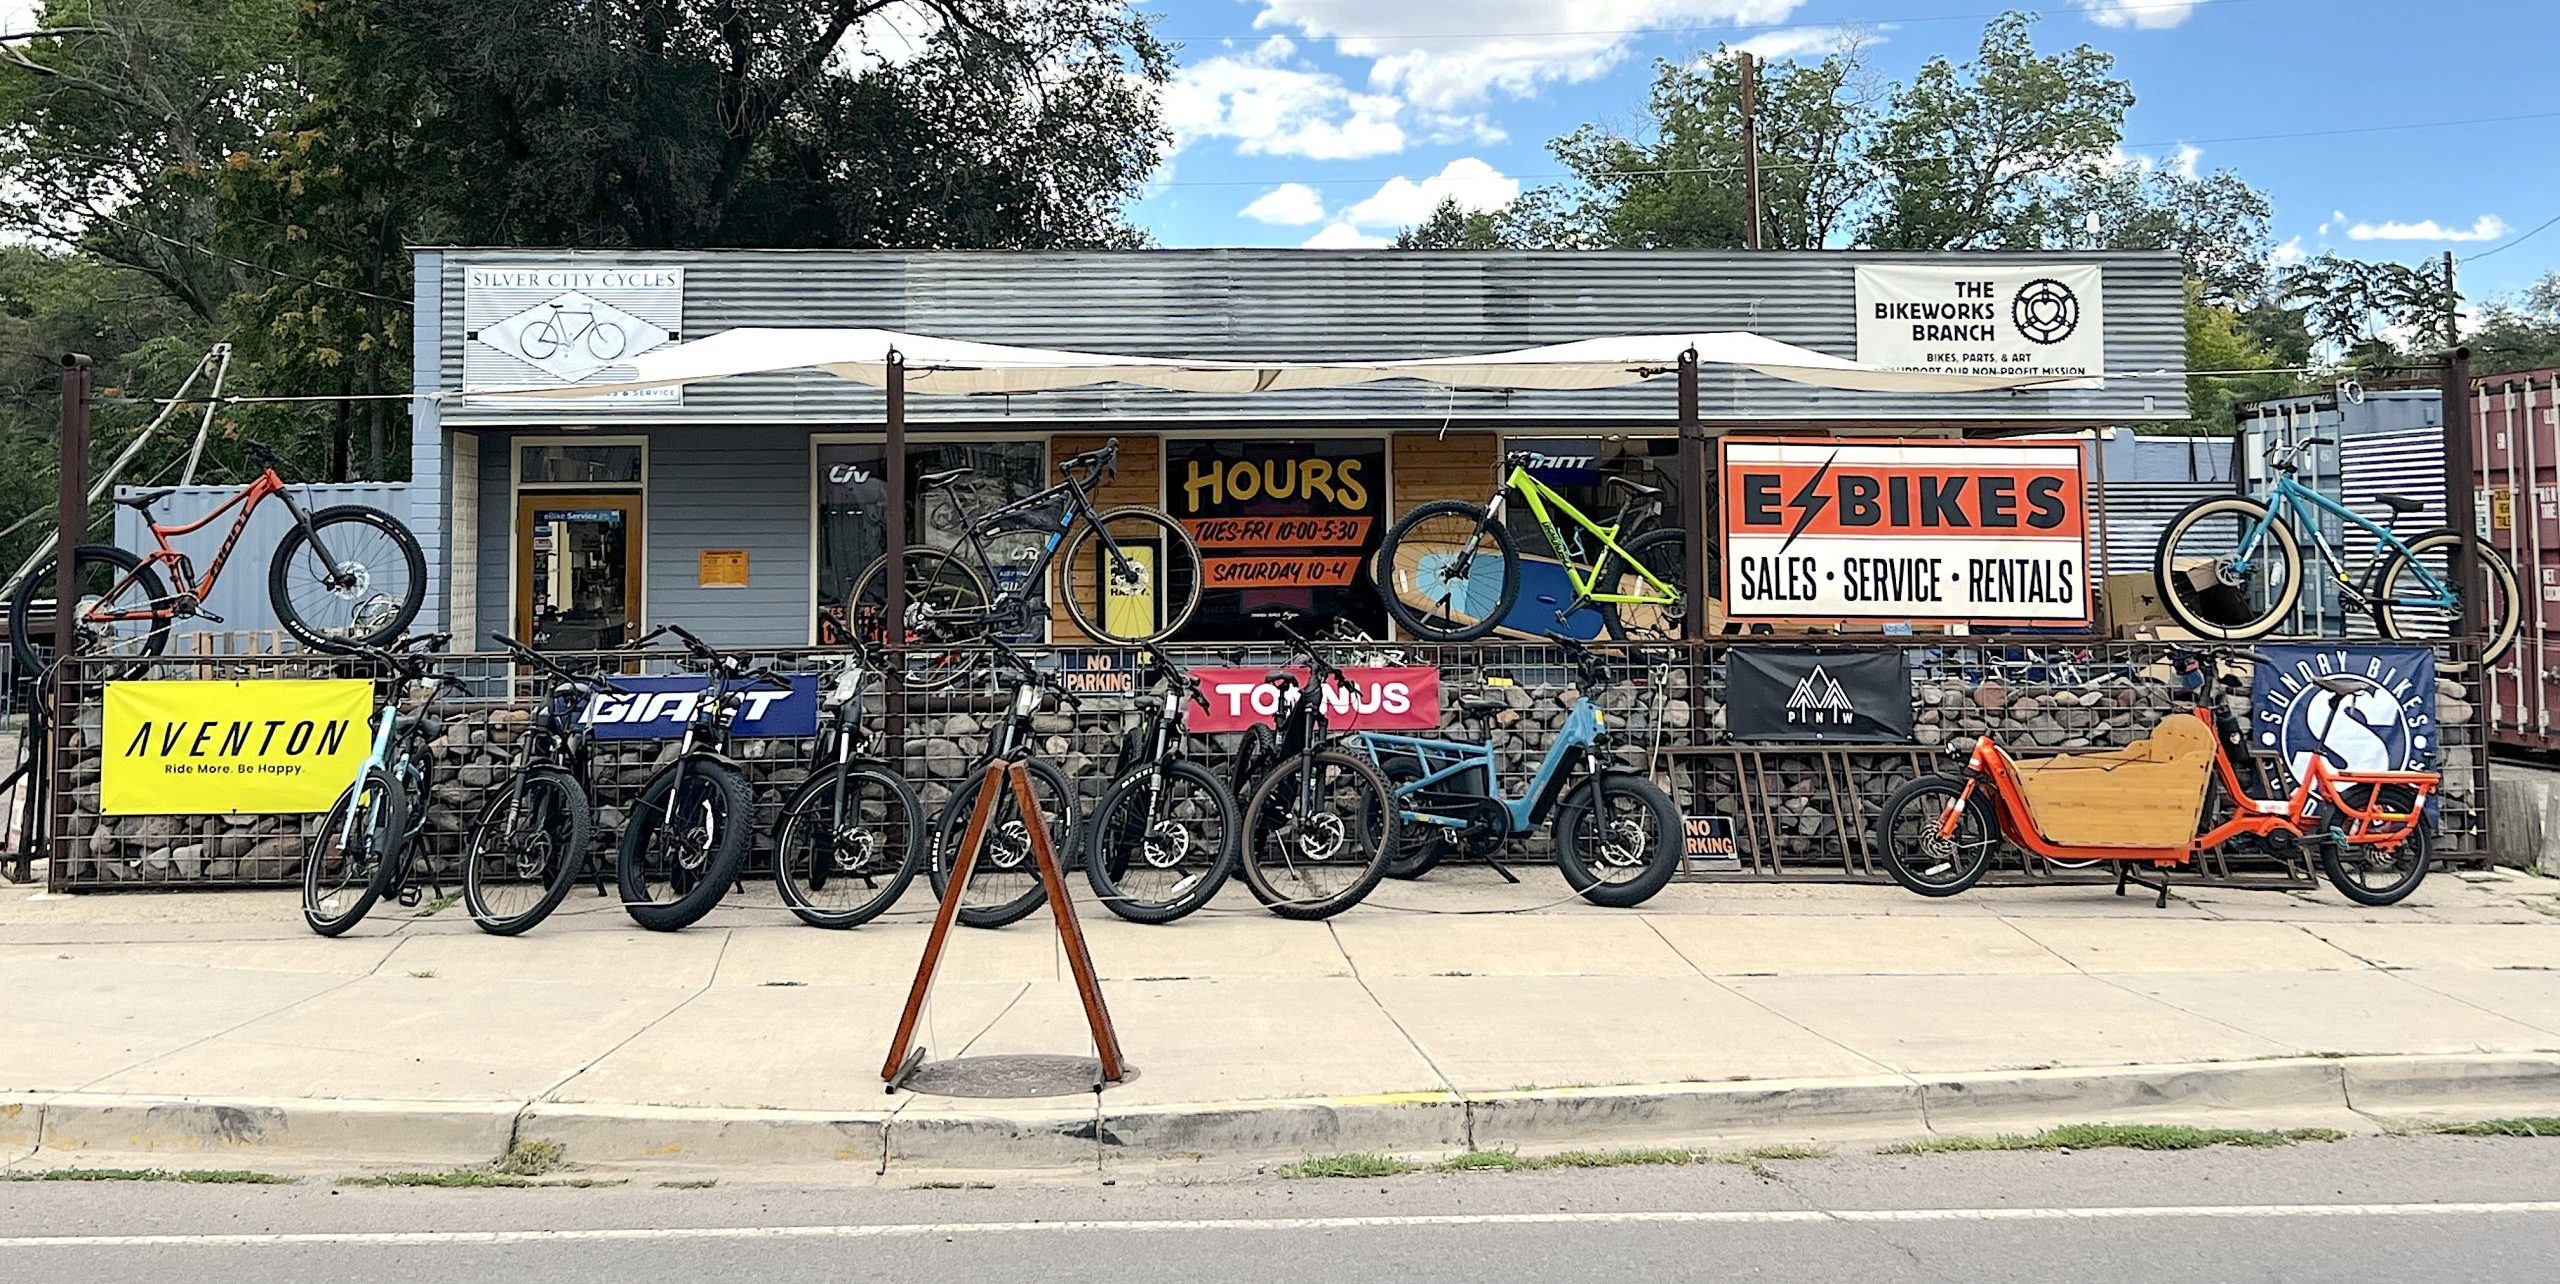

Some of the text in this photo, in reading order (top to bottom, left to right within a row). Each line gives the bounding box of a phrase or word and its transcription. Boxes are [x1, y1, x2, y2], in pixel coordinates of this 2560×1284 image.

[474, 273, 675, 286] SILVER CITY CYCLES
[1955, 281, 1994, 298] THE
[1875, 303, 1995, 320] BIKEWORKS
[1912, 324, 1995, 341] BRANCH
[1927, 353, 2032, 363] BIKES, PARTS, & ART
[1972, 367, 2038, 375] NON-PROFIT
[2043, 367, 2085, 375] MISSION
[1528, 456, 1595, 469] IANT
[1184, 459, 1367, 512] HOURS
[1195, 519, 1359, 542] TUES-FRI 10:00-5:30
[1214, 561, 1347, 584] SATURDAY 10-4
[1741, 556, 2073, 604] SALES SERVICE RENTALS
[1087, 654, 1112, 671] NO
[1067, 673, 1132, 691] PARKING
[2260, 651, 2429, 729] SUNDAY BIKES
[125, 720, 349, 757] AVENTON
[165, 764, 305, 776] Ride More. Be Happy.
[1121, 767, 1153, 789] MAXXI
[1686, 820, 1711, 836] NO
[1686, 837, 1734, 854] RKING
